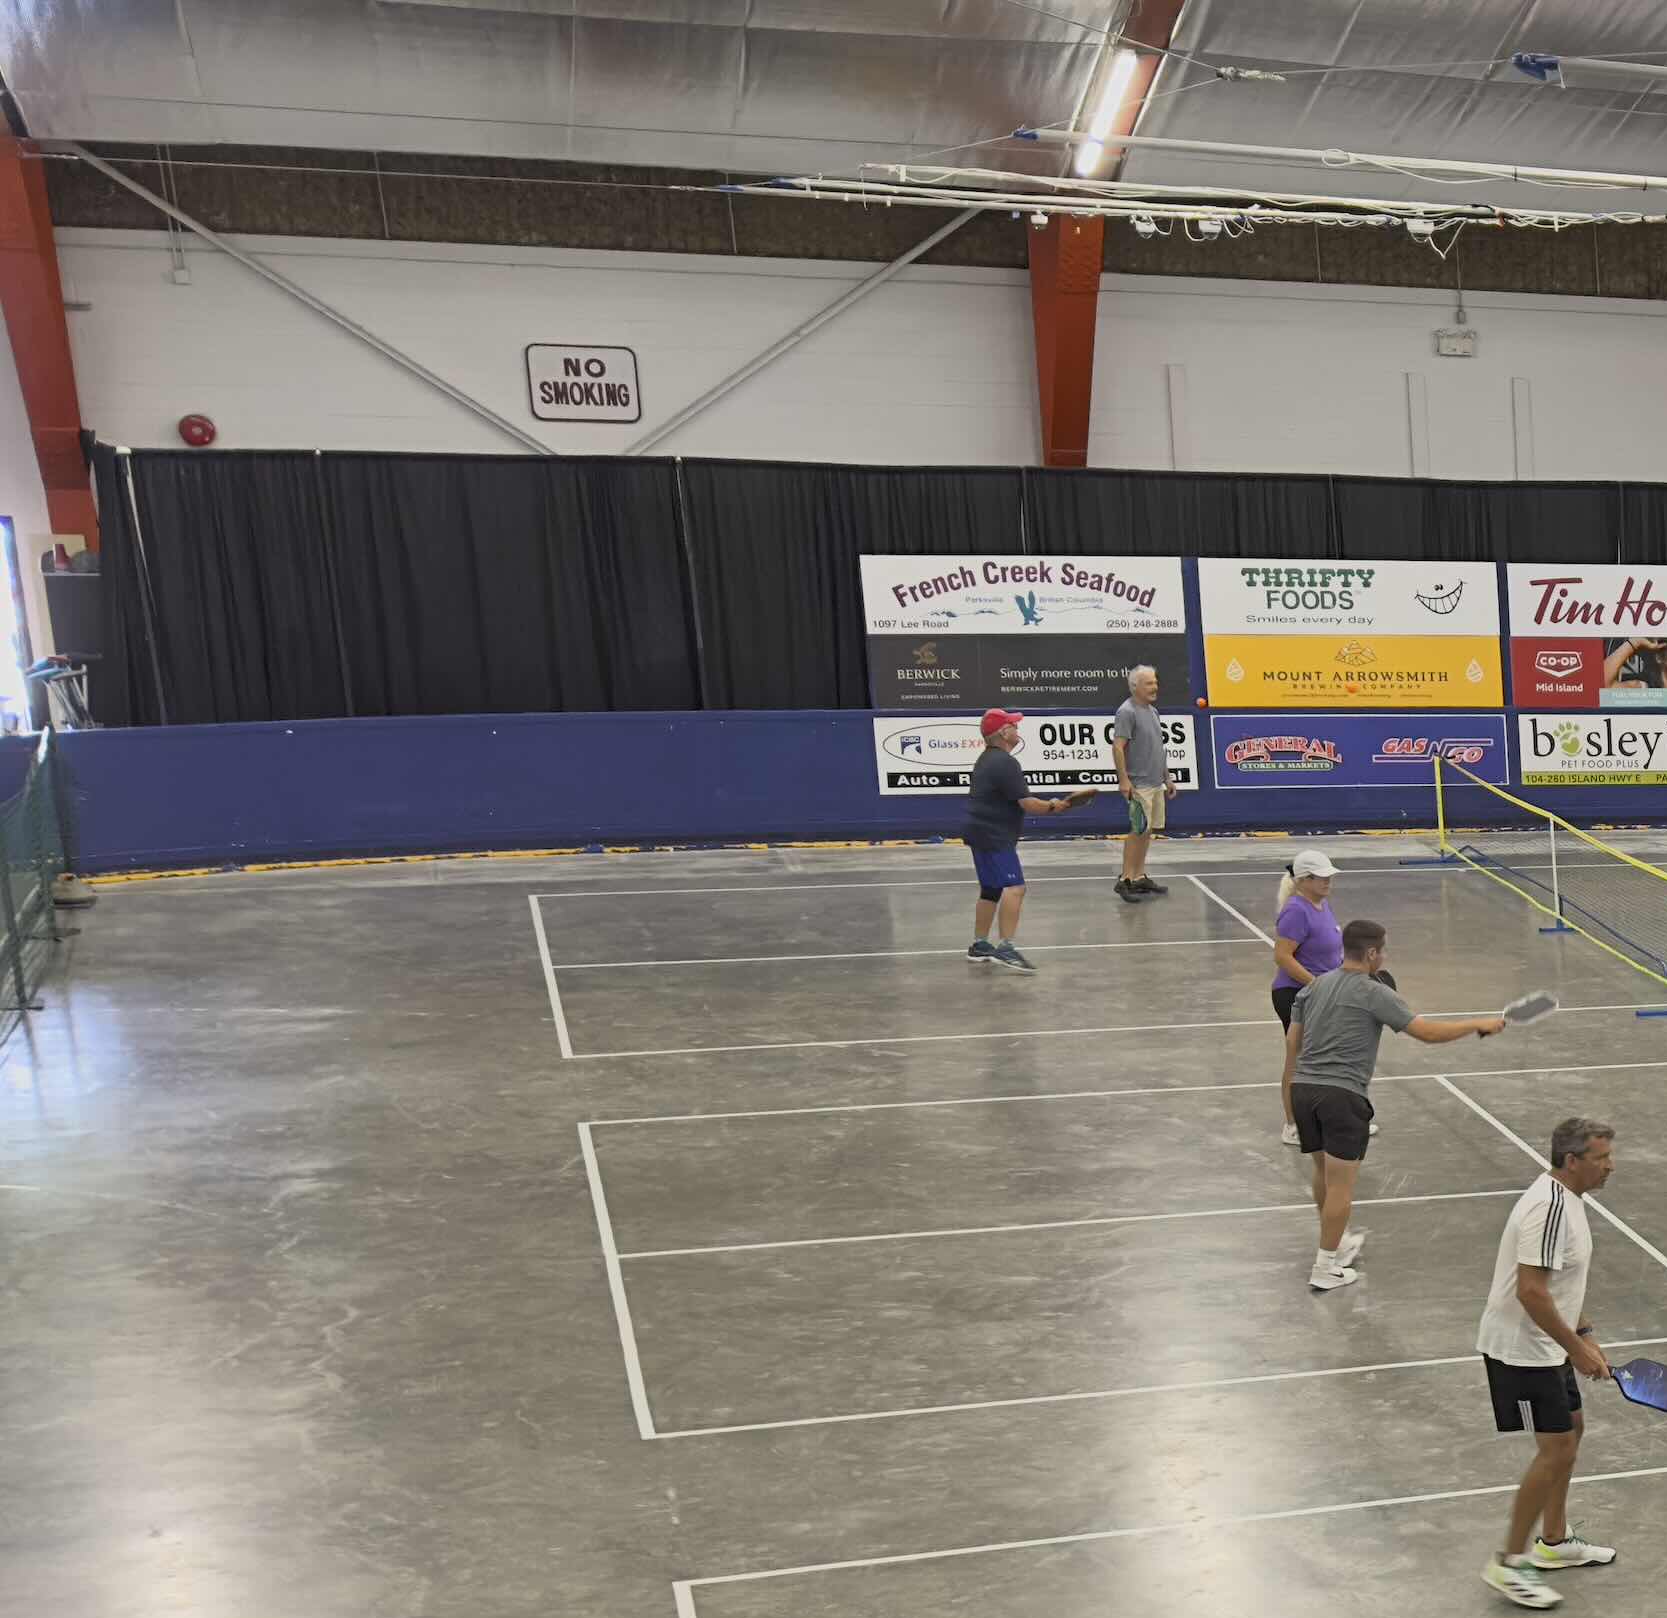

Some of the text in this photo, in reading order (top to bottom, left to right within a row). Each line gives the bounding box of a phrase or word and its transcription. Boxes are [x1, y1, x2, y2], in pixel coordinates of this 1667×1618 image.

[563, 358, 606, 378] NO
[540, 381, 630, 407] SMOKING
[1241, 567, 1375, 588] THRIFTY
[892, 561, 1156, 608] French Creek Seafood
[1266, 590, 1354, 610] FOODS
[1530, 577, 1604, 626] Tim
[873, 620, 949, 628] 1097 Lee Road
[1106, 620, 1178, 629] (250) 248-2888
[1246, 614, 1375, 625] Smiles every day
[1539, 656, 1578, 666] CO-OP
[897, 668, 960, 679] BERWICK
[1000, 667, 1119, 681] Simply more room to
[1263, 671, 1449, 682] MOUNT ARROWSMITH
[1536, 683, 1583, 692] Mid Island
[1039, 723, 1186, 745] OUR GSS
[928, 738, 959, 749] Glass
[1382, 737, 1428, 754] GAS
[1042, 749, 1099, 760] 954-1234
[1225, 736, 1342, 763] GENERAL
[1287, 761, 1330, 769] MARKETS
[1561, 760, 1640, 768] PET FOOD PLUS
[897, 774, 939, 786] Auto
[1525, 774, 1641, 783] 104-280 ISLAND HWY E
